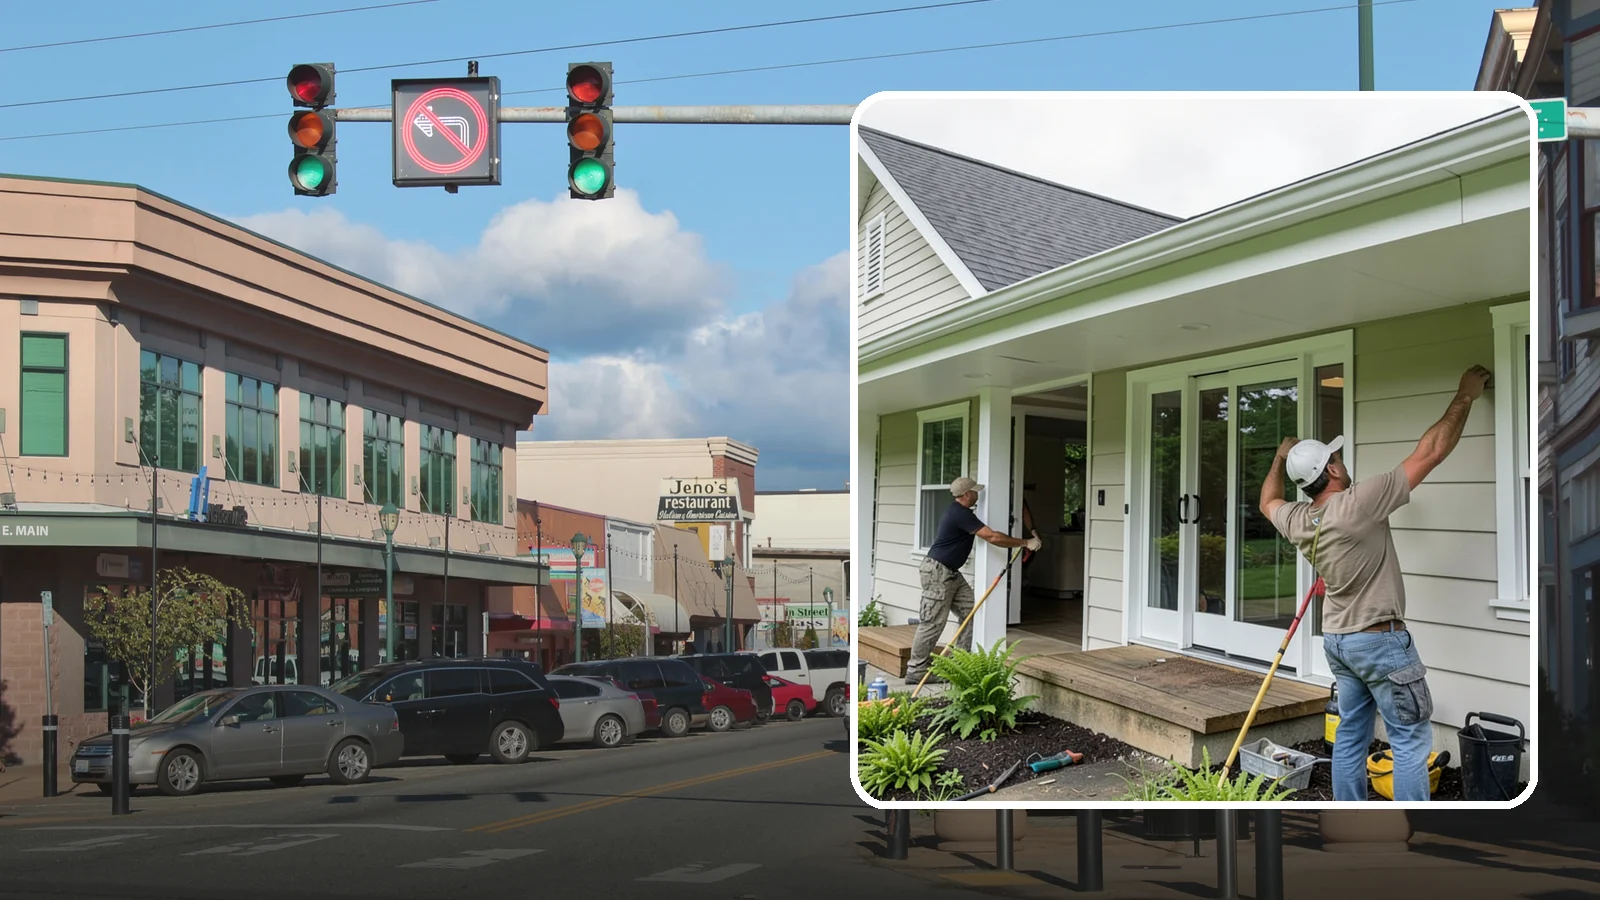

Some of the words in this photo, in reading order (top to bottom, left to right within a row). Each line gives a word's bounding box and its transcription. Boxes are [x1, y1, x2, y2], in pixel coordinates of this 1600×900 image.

[670, 480, 728, 495] Jeno's
[665, 496, 731, 509] restaurant
[658, 509, 682, 520] Italian
[686, 509, 714, 519] American
[715, 509, 738, 519] Cuisine
[2, 525, 13, 536] E.
[15, 525, 49, 536] MAIN
[797, 607, 829, 617] Street
